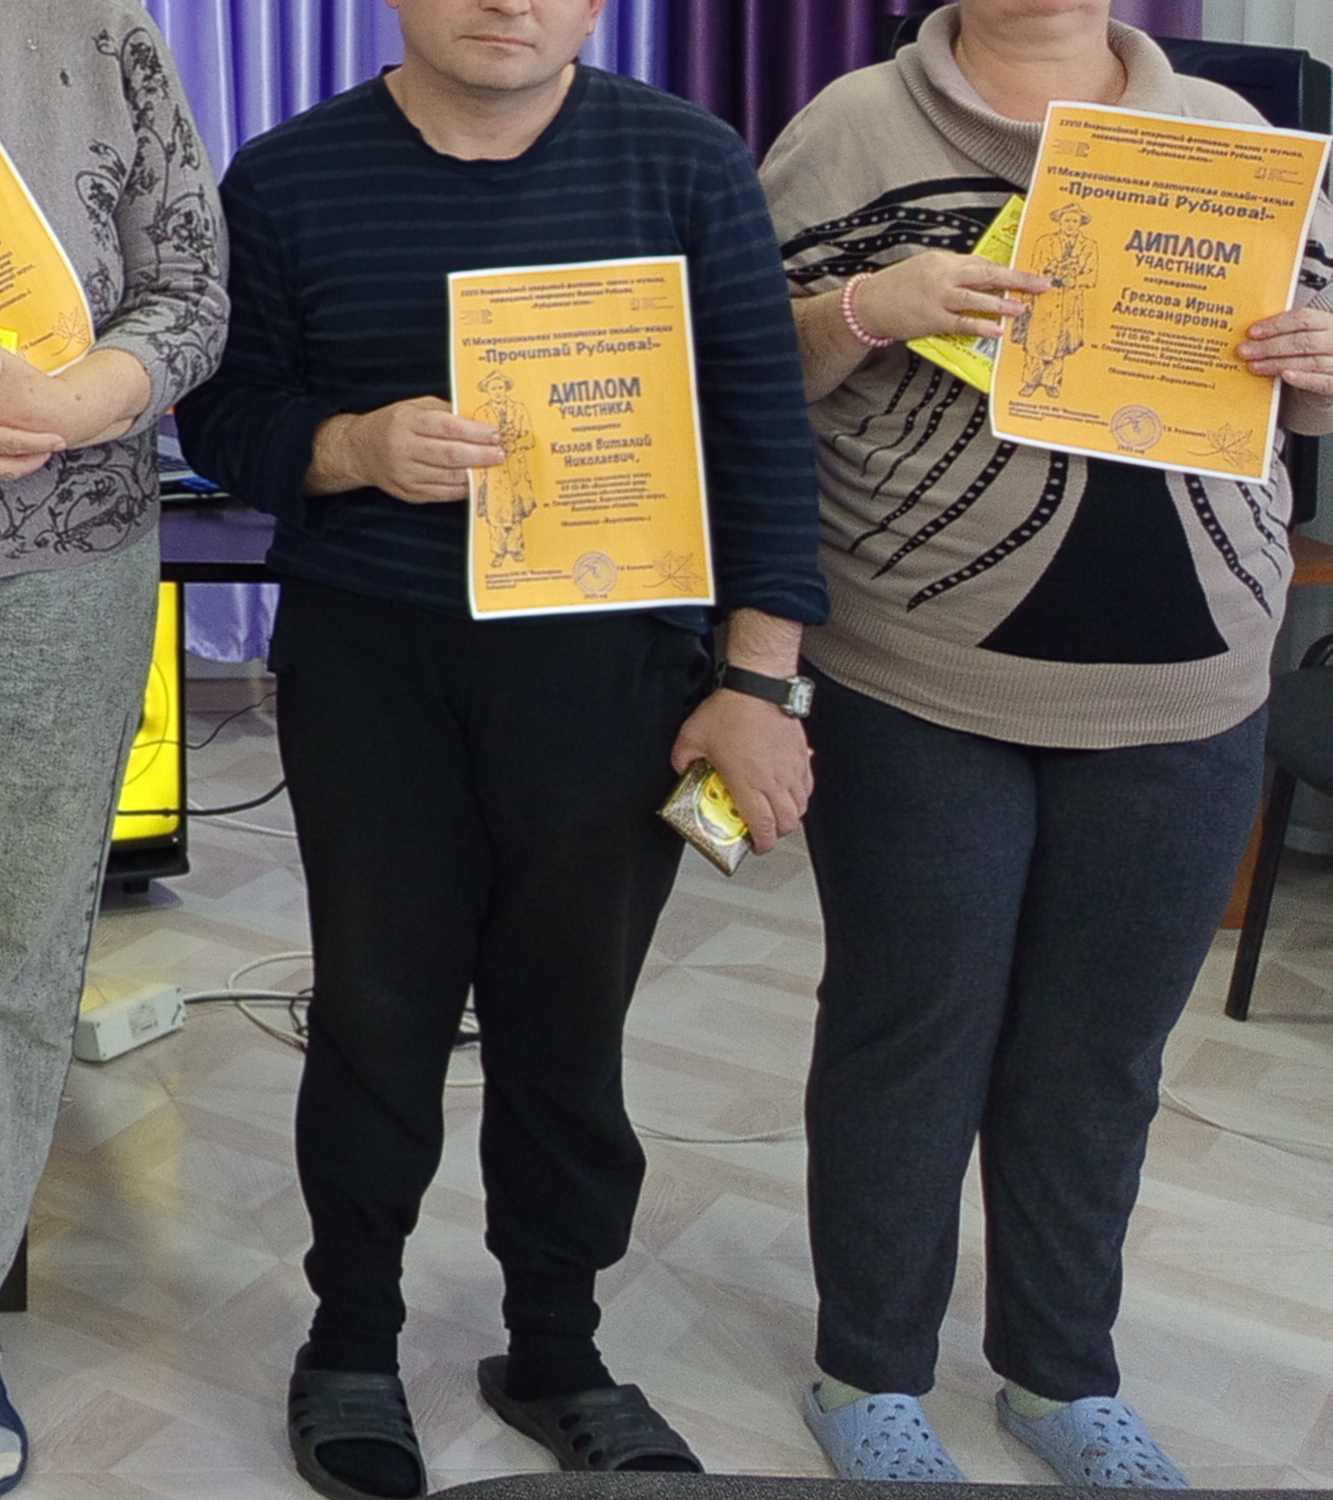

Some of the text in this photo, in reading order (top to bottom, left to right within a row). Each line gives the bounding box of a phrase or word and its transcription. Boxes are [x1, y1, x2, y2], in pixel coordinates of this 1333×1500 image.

[1058, 167, 1150, 187] Межрегиональная
[1152, 182, 1218, 196] поэтическая
[1124, 229, 1242, 265] ДИПЛОМ
[1135, 254, 1226, 279] УЧАСТНИКА
[1121, 287, 1233, 315] Грехова Ирина
[1112, 301, 1233, 332] Александровна,
[548, 377, 642, 406] ДИПЛОМ
[559, 401, 634, 419] УЧАСТНИКА
[551, 434, 652, 454] Козлов Виталий
